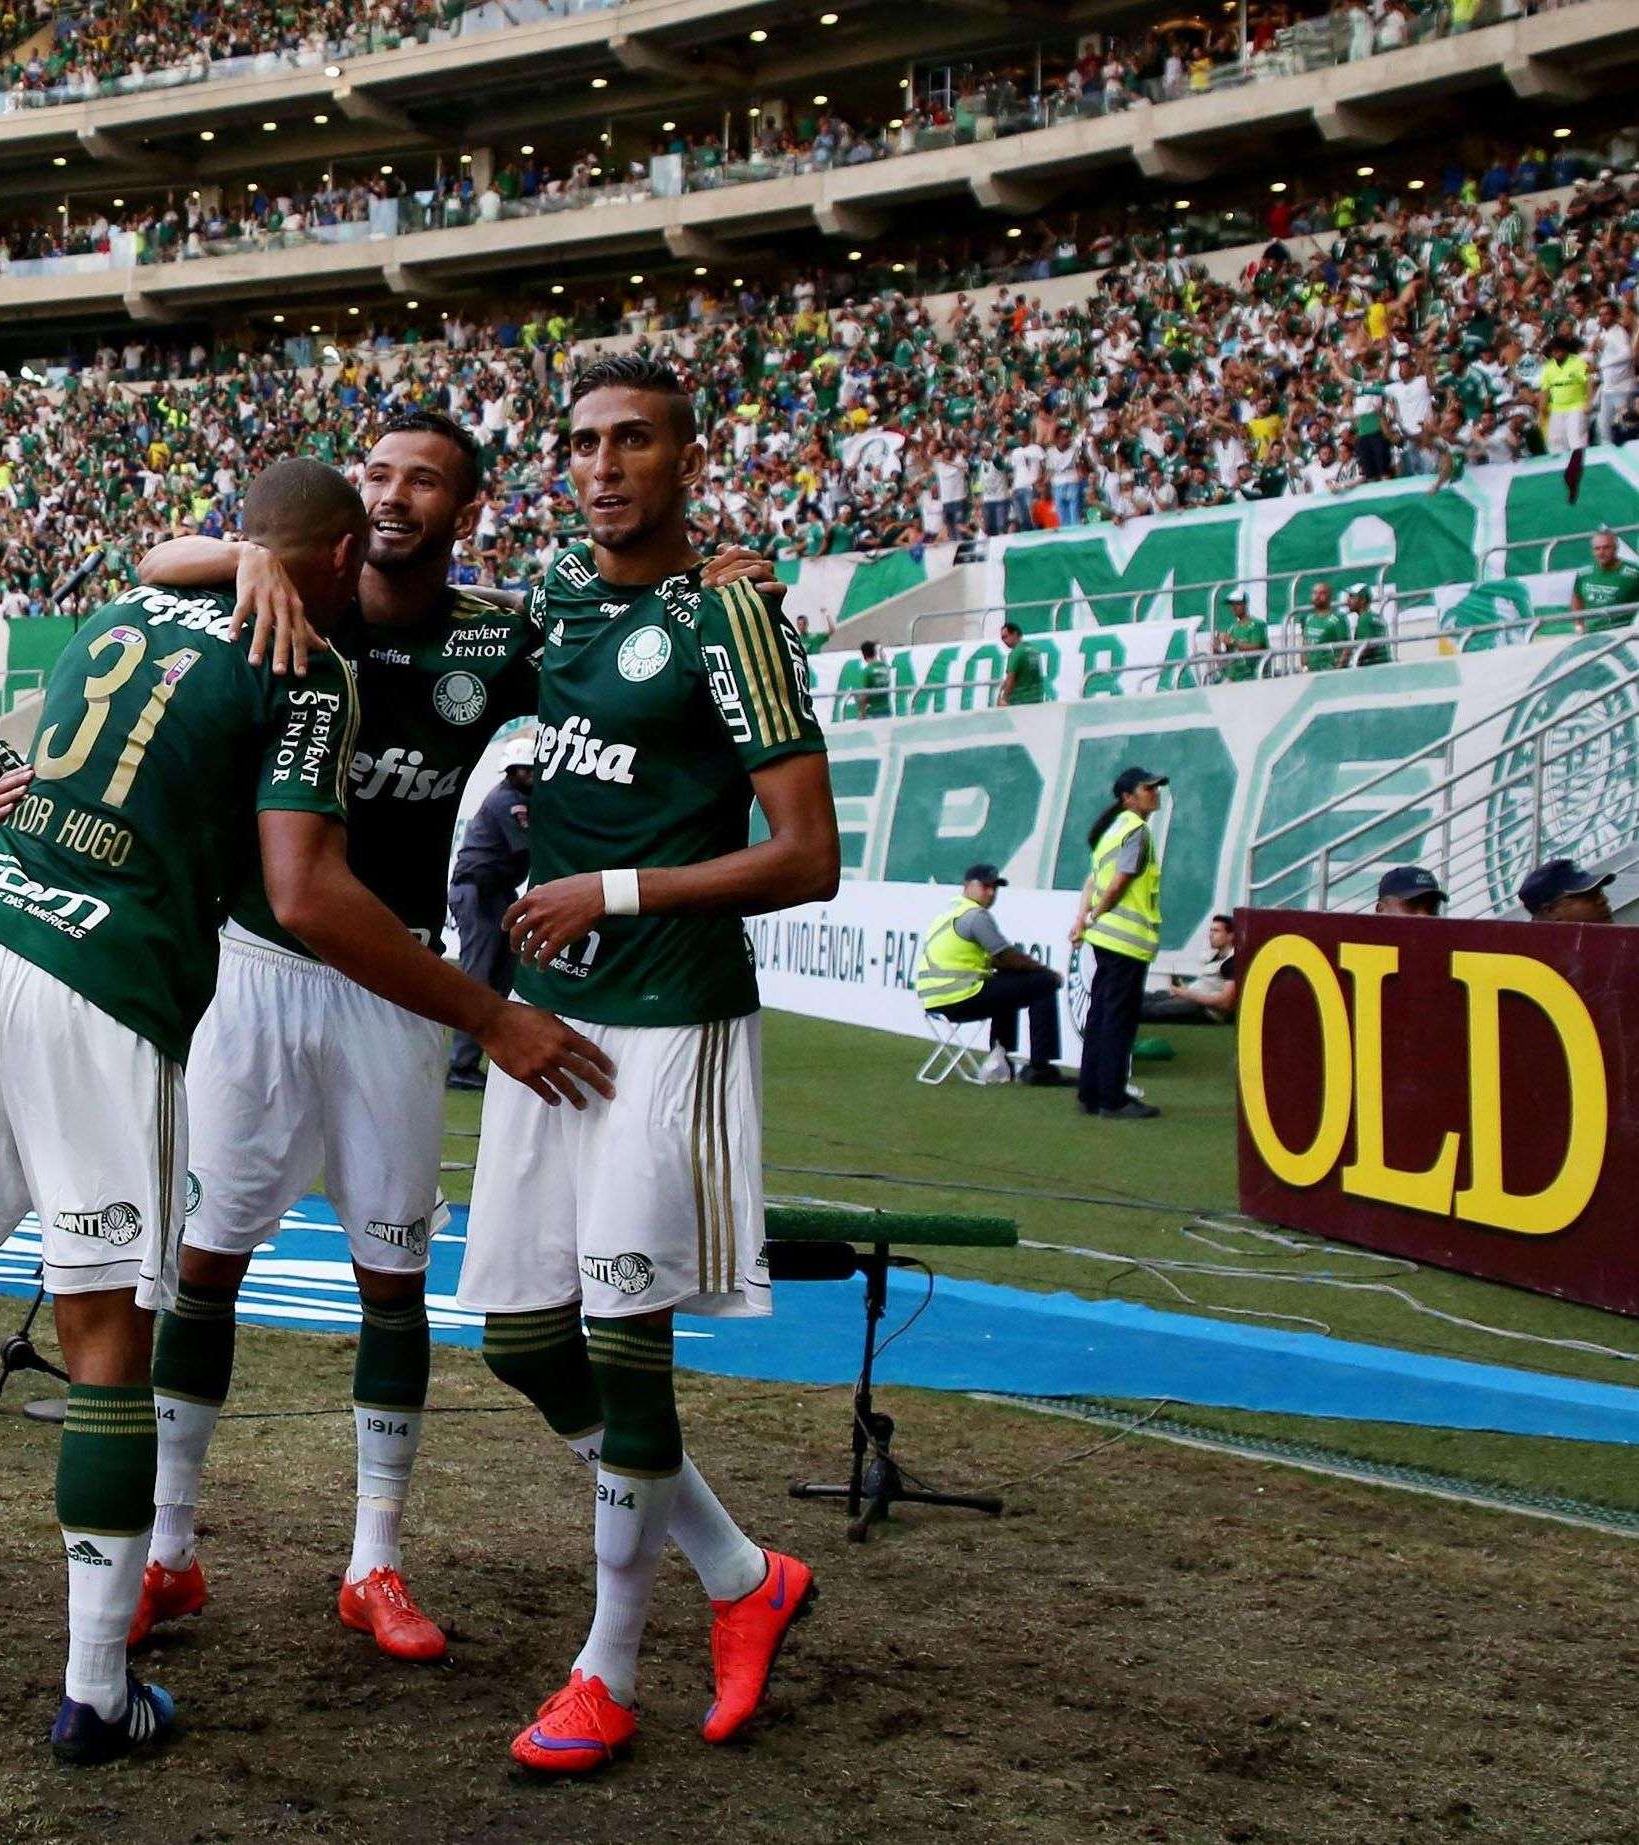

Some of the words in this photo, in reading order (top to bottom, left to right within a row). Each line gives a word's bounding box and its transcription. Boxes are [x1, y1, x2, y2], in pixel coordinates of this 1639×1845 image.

[442, 641, 507, 657] SENIOR
[450, 624, 510, 642] PREVENT
[369, 648, 411, 665] crefisa
[33, 625, 202, 809] 31
[437, 692, 484, 722] PALMEIRAS
[272, 690, 317, 785] SENIOR
[299, 690, 339, 787] PREVENT
[348, 747, 463, 801] efisa
[56, 809, 134, 867] HUGO
[3, 894, 26, 909] DAS
[786, 910, 865, 983] VIOLÊNCIA
[883, 929, 919, 990] PAZ
[1238, 933, 1608, 1234] OLD
[367, 1417, 409, 1437] 1914
[598, 1484, 637, 1509] 914
